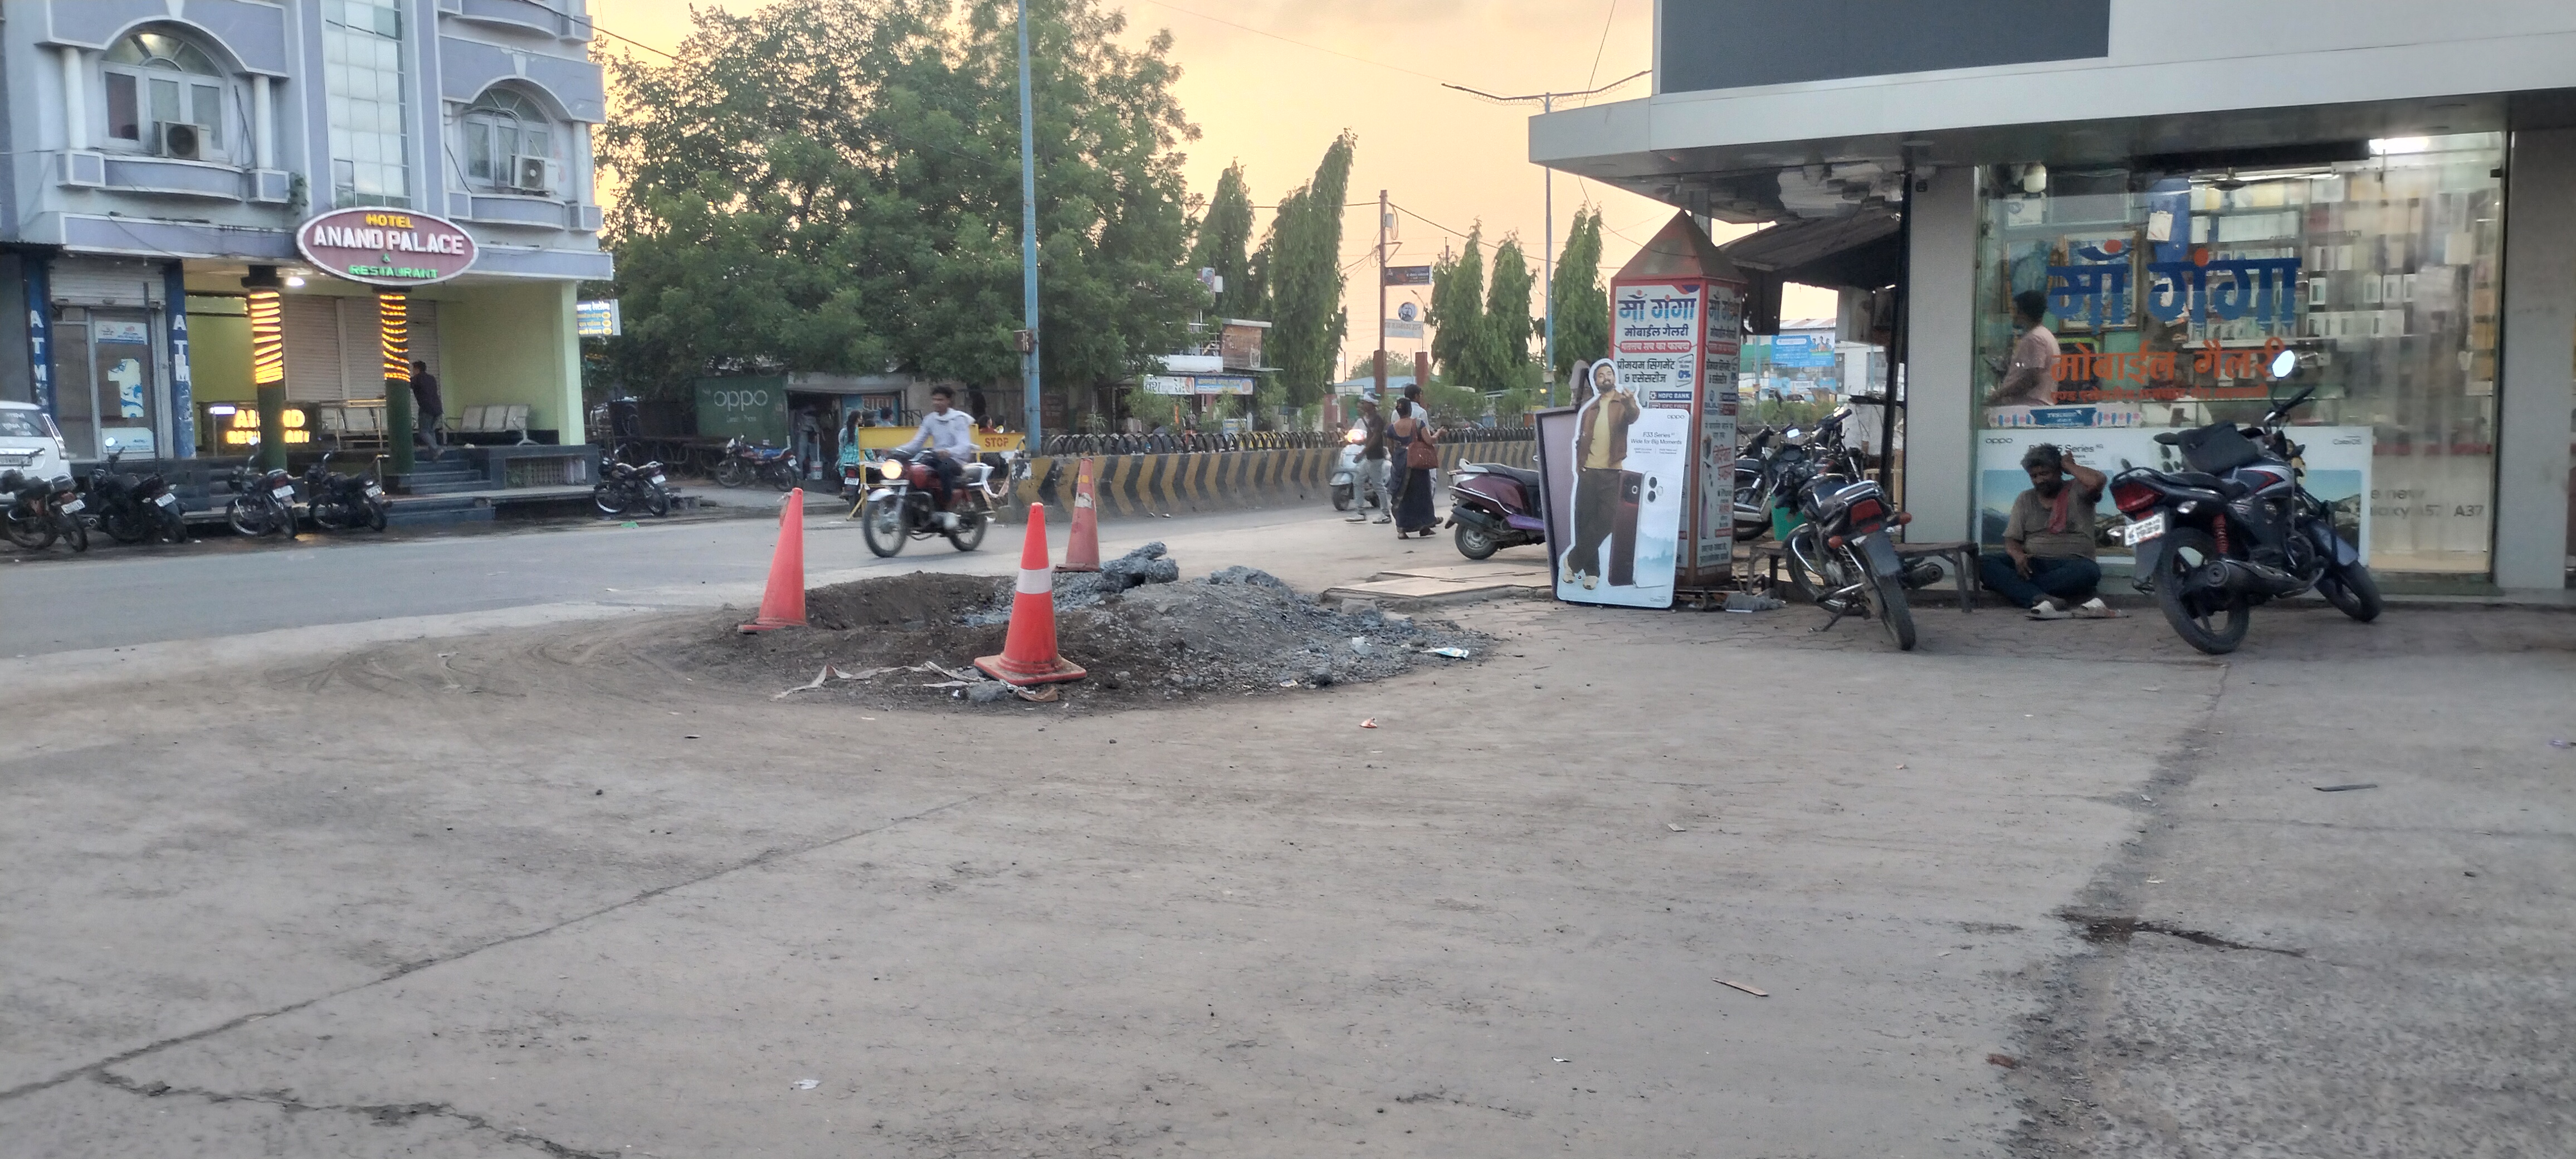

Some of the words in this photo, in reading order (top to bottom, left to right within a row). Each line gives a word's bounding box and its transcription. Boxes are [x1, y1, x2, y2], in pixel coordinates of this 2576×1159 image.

[366, 214, 414, 229] HOTEL
[313, 225, 384, 249] ANAND
[386, 230, 465, 255] PALACE
[382, 253, 391, 262] &
[348, 265, 438, 279] RESTAURANT
[2046, 239, 2134, 334] माँ
[2147, 248, 2301, 327] गंगा
[1618, 289, 1647, 322] माँ
[1650, 294, 1696, 320] गंगा
[1624, 323, 1661, 338] मोबाईल
[1662, 323, 1689, 337] गैलरी
[30, 310, 47, 382] ATM
[173, 314, 190, 382] ATM
[2051, 340, 2177, 383] मोबाईल
[2194, 337, 2286, 379] गैलरी
[714, 390, 768, 411] oppo
[233, 410, 305, 428] ANND
[985, 437, 1008, 447] STOP
[2454, 505, 2484, 517] A37
